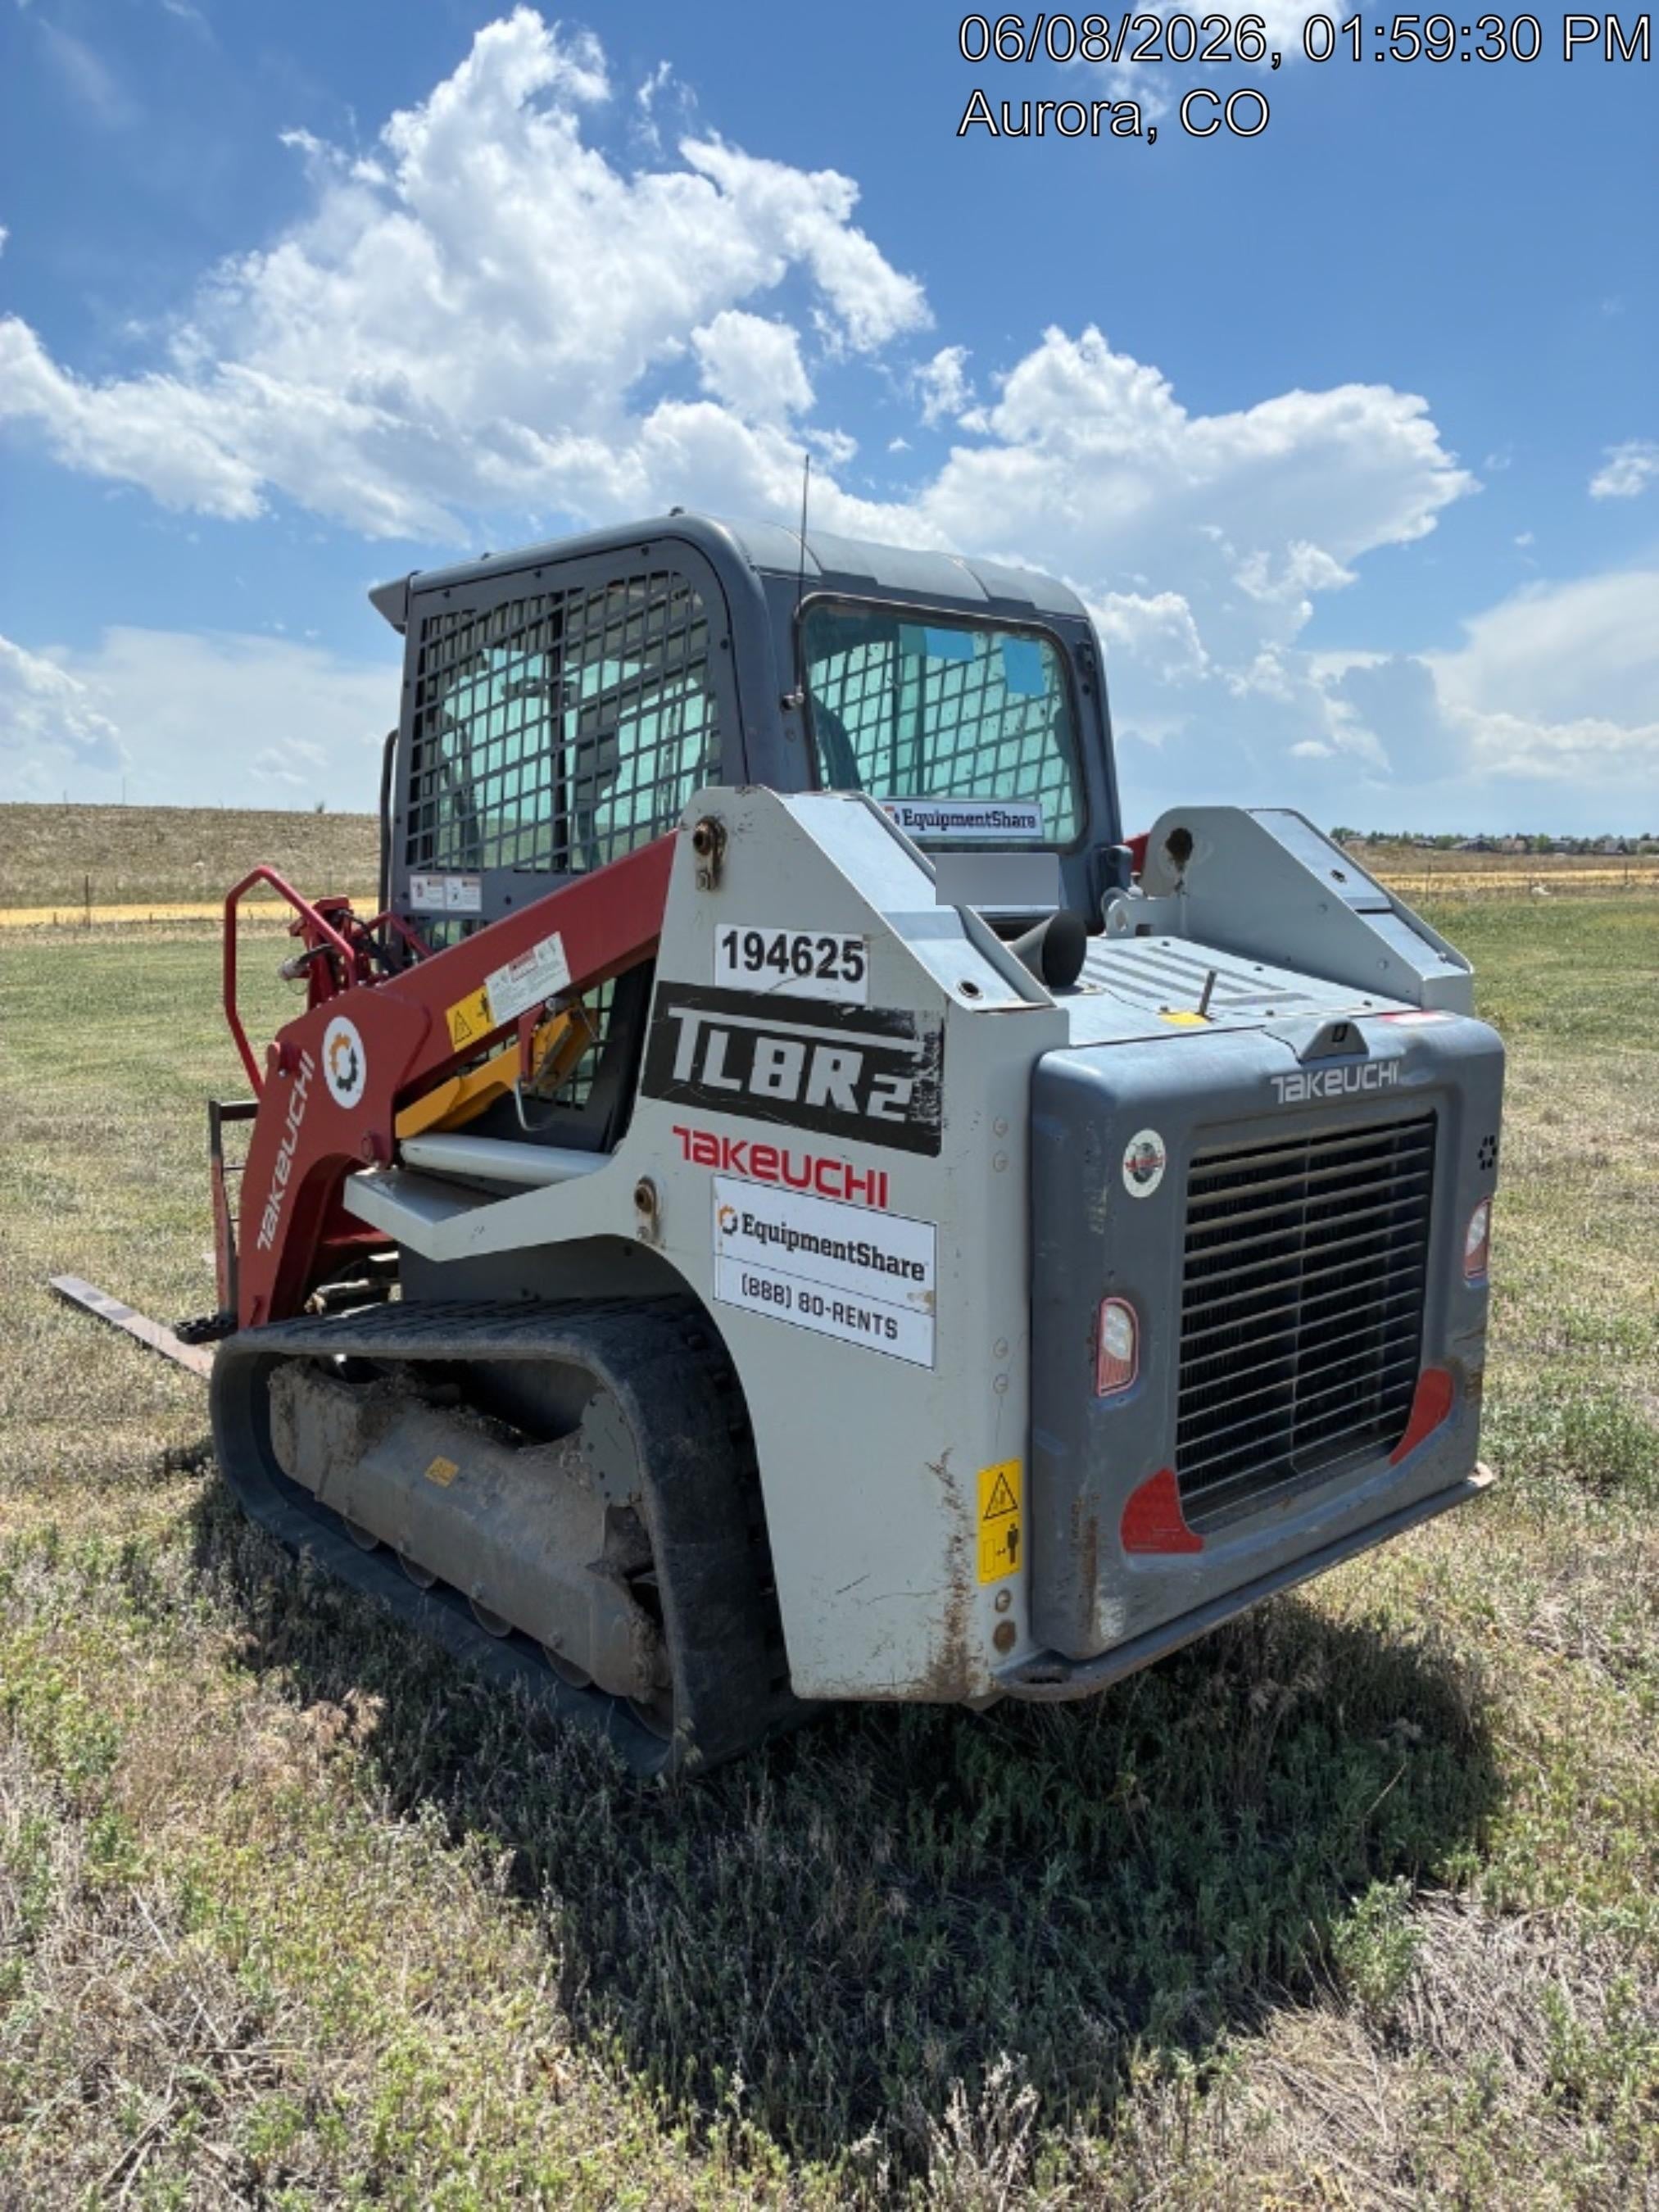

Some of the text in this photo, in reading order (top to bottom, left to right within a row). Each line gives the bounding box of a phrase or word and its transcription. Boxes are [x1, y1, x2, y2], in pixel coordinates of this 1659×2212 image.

[902, 808, 1036, 832] EquipmentShare
[722, 930, 864, 984] 194625
[668, 1007, 924, 1123] TL8R2
[741, 1213, 926, 1281] EquipmentShare
[741, 1271, 899, 1340] (888) 80-RENTS
